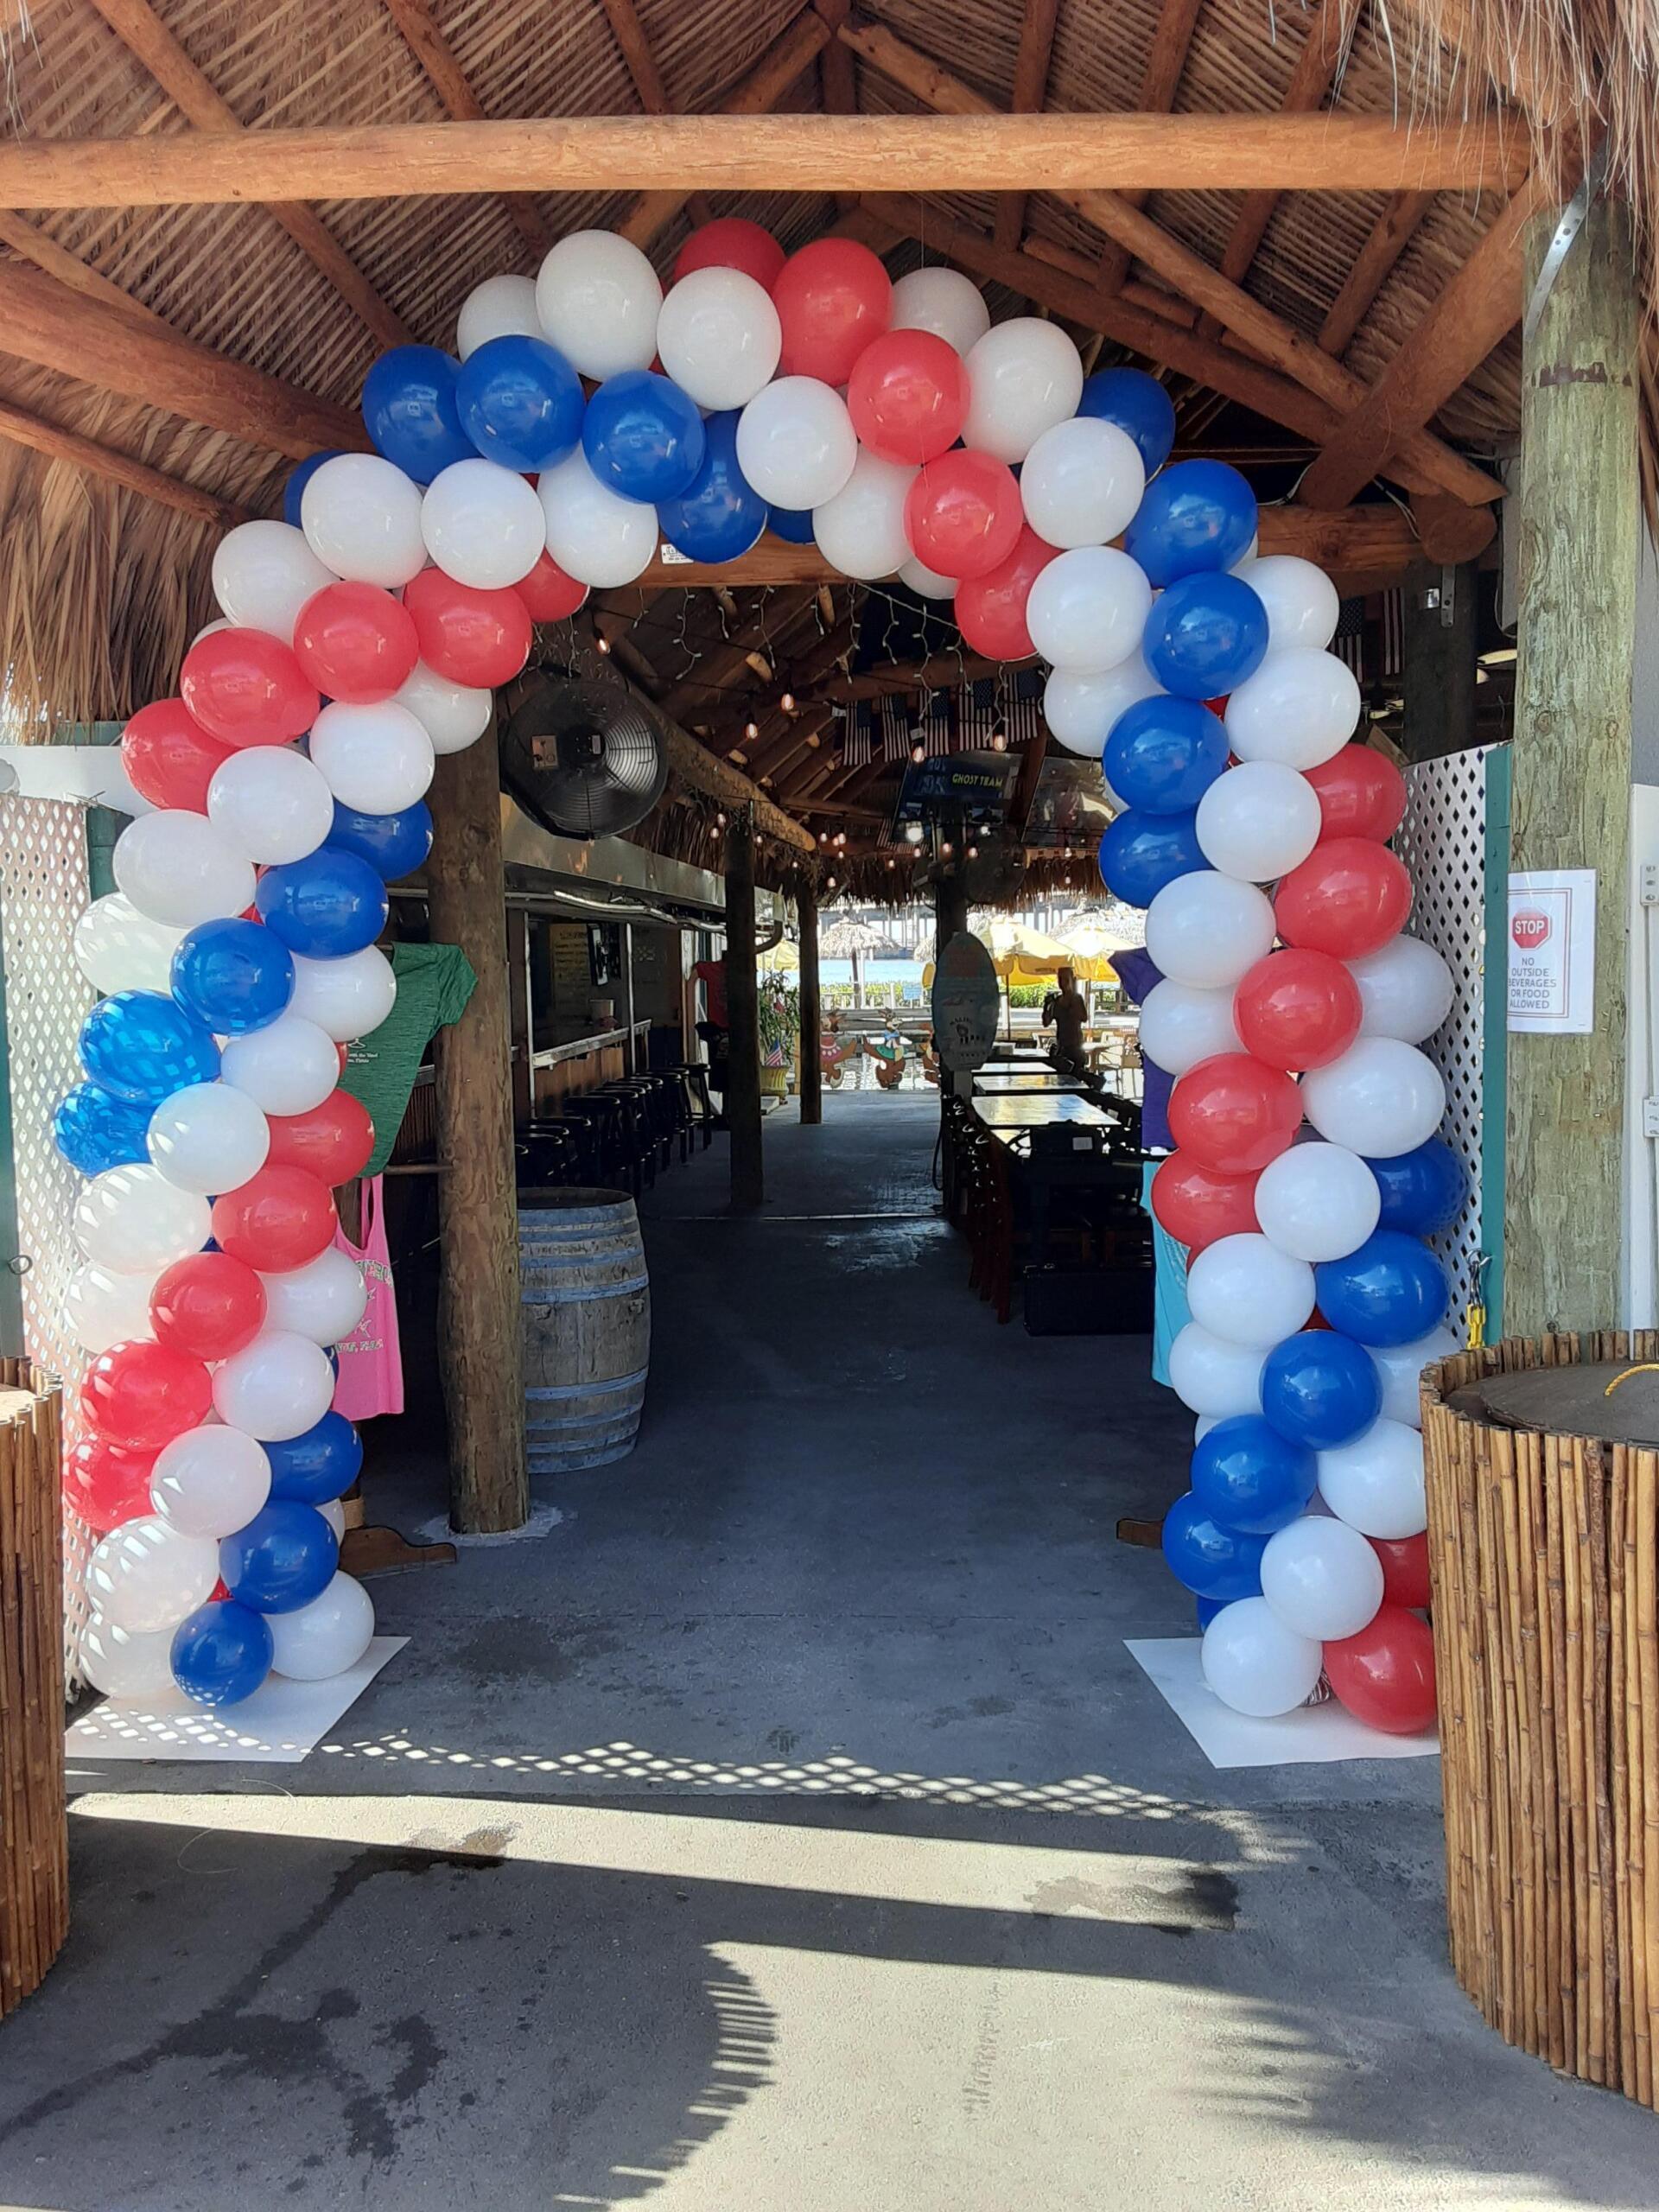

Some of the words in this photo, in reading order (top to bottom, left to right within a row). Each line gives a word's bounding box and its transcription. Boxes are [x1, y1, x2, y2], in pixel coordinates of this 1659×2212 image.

[951, 772, 978, 786] GHOST
[980, 775, 1003, 788] TEAM
[1515, 920, 1545, 934] STOP
[1522, 957, 1535, 966] NO
[1511, 968, 1549, 976] OUTSIDE
[1510, 989, 1521, 998] OR
[1522, 989, 1550, 998] FOOD
[1510, 1000, 1550, 1009] ALLOWED
